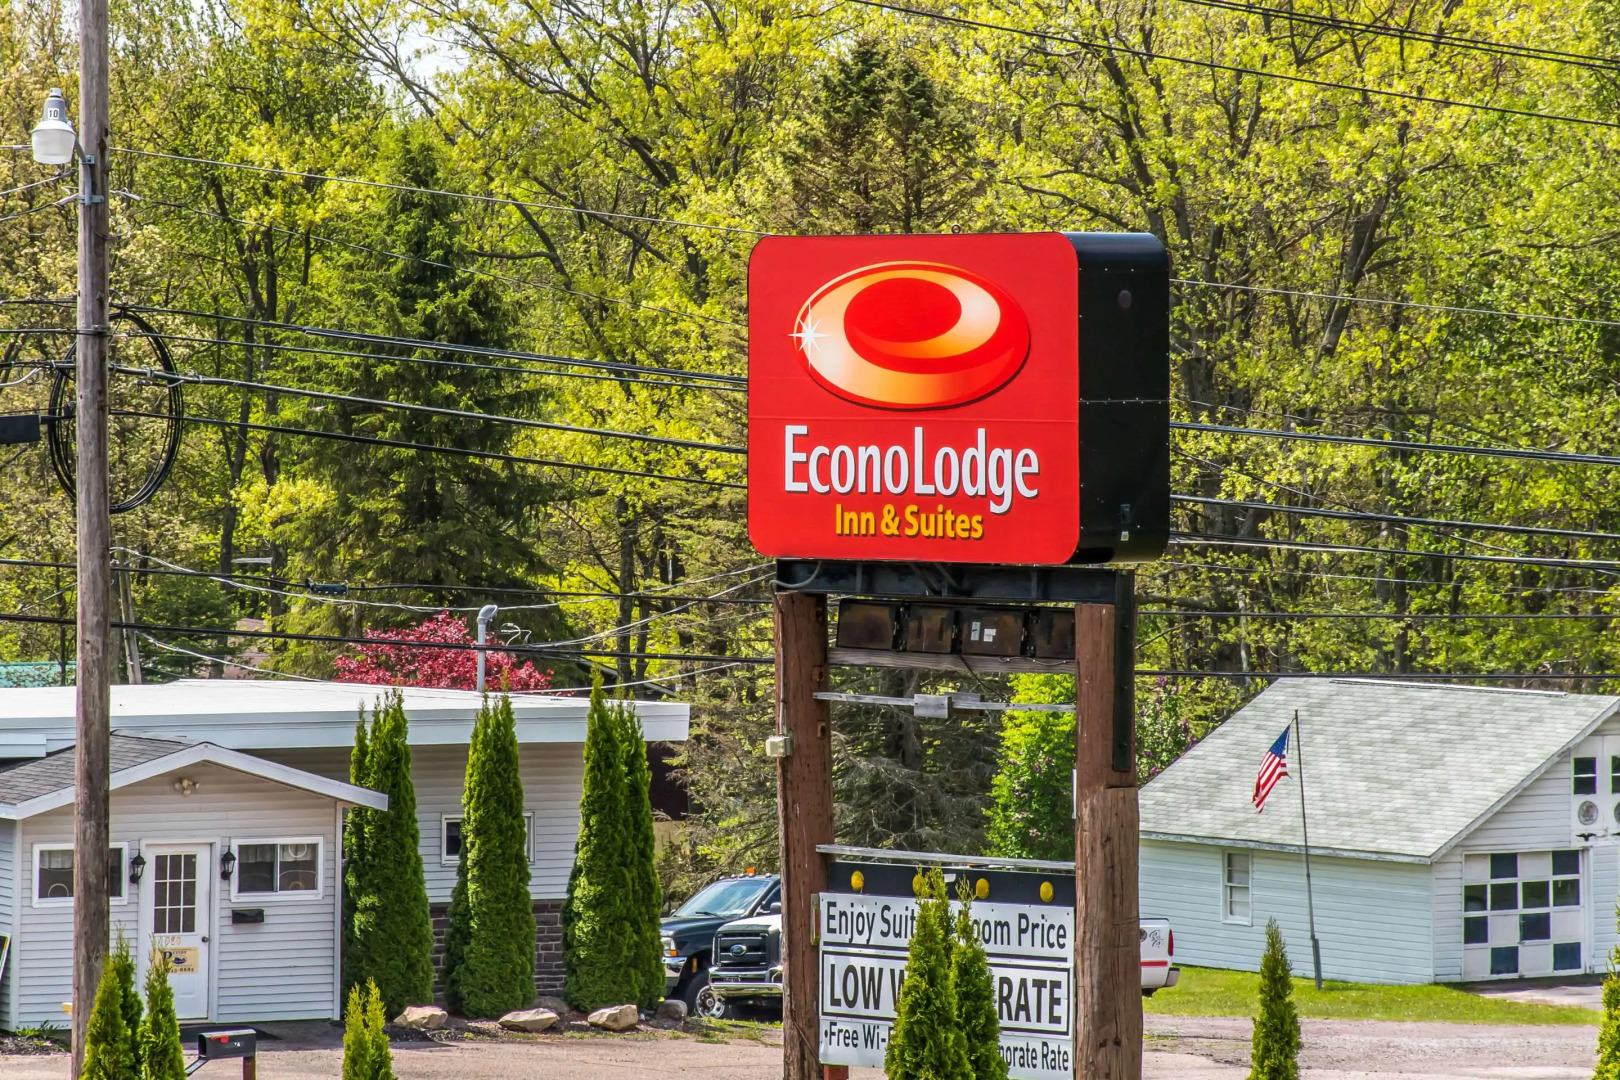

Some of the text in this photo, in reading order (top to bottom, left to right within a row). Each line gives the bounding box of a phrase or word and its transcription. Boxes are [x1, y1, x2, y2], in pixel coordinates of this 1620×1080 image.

[49, 109, 59, 118] 10
[784, 424, 1040, 514] EconoLodge
[835, 504, 984, 539] Inn & Suites
[826, 901, 876, 945] Enjoy
[880, 904, 916, 939] Suit
[1017, 912, 1067, 949] Price
[829, 963, 884, 1010] LOW
[998, 976, 1062, 1025] RATE
[828, 1021, 859, 1048] Free
[999, 1041, 1038, 1071] orate
[1041, 1041, 1069, 1072] Rate
